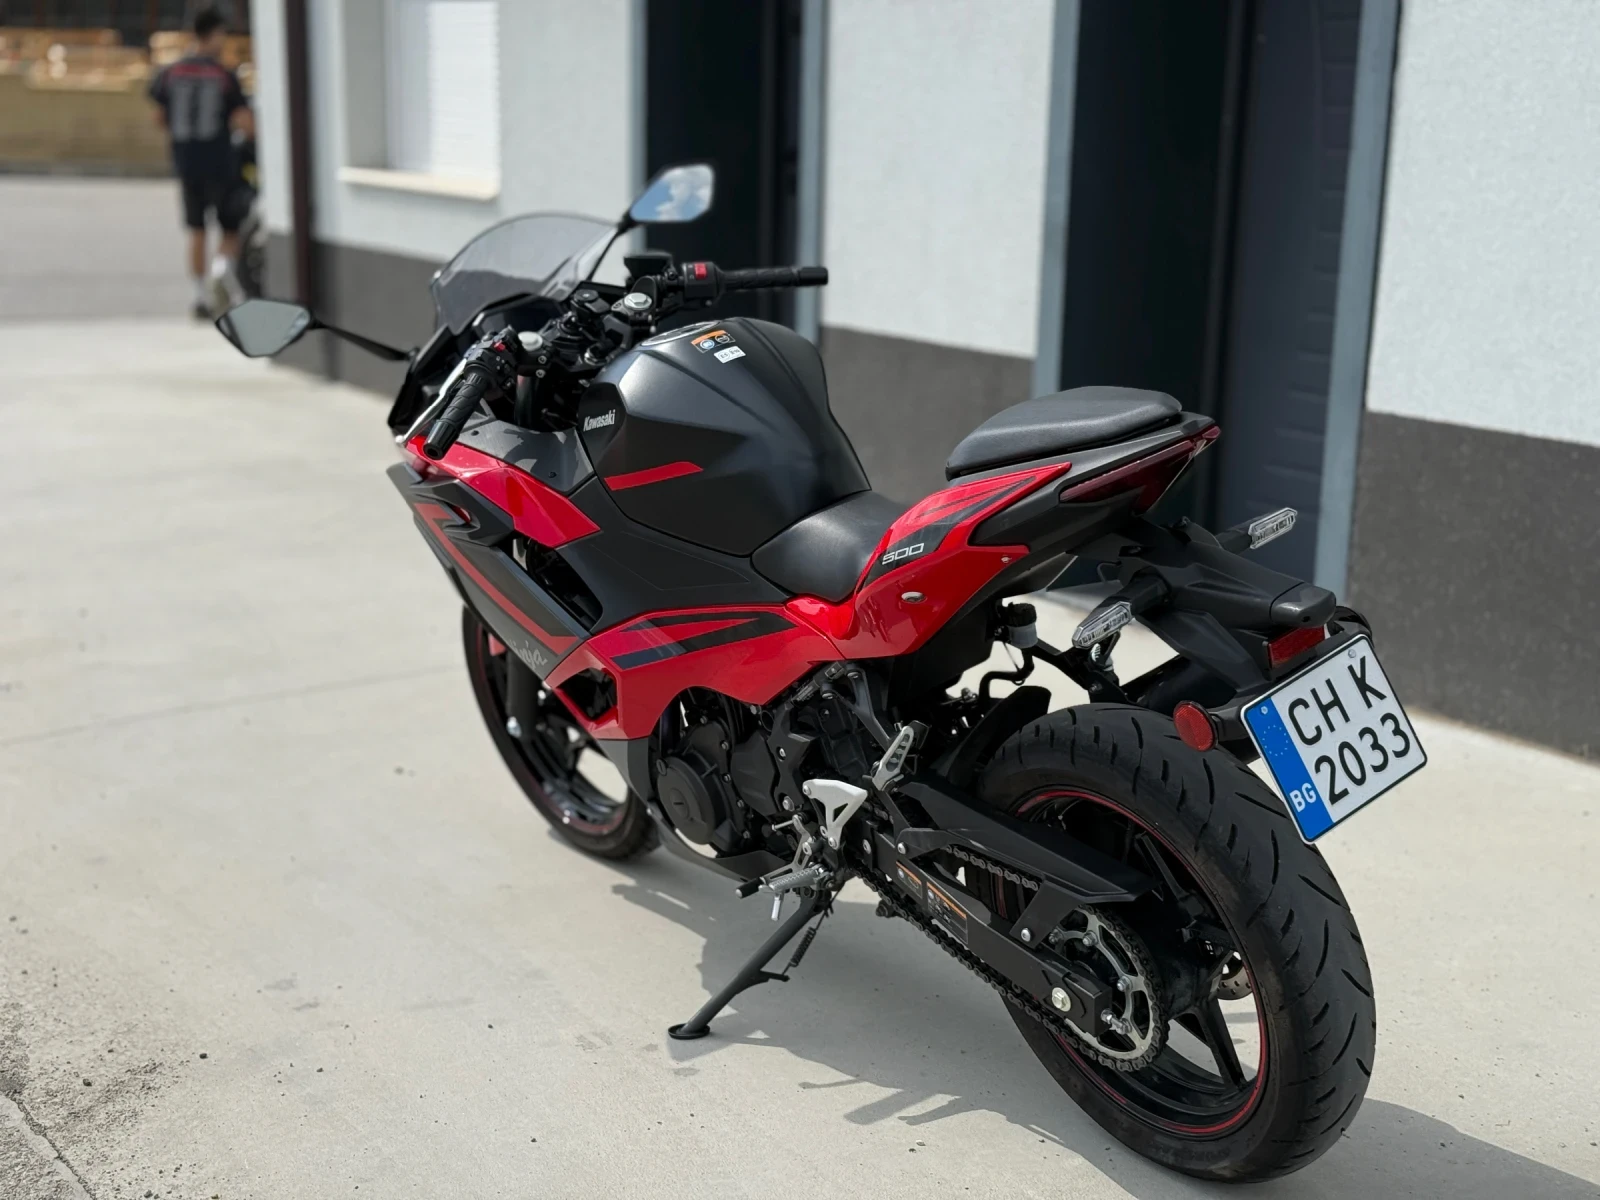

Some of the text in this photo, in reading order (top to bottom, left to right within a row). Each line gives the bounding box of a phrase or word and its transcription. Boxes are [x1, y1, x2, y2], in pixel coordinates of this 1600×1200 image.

[583, 409, 616, 431] Kawasaki
[881, 542, 925, 566] 500
[1287, 655, 1387, 746] CH K
[1314, 712, 1411, 806] 2033
[1289, 782, 1317, 812] BG
